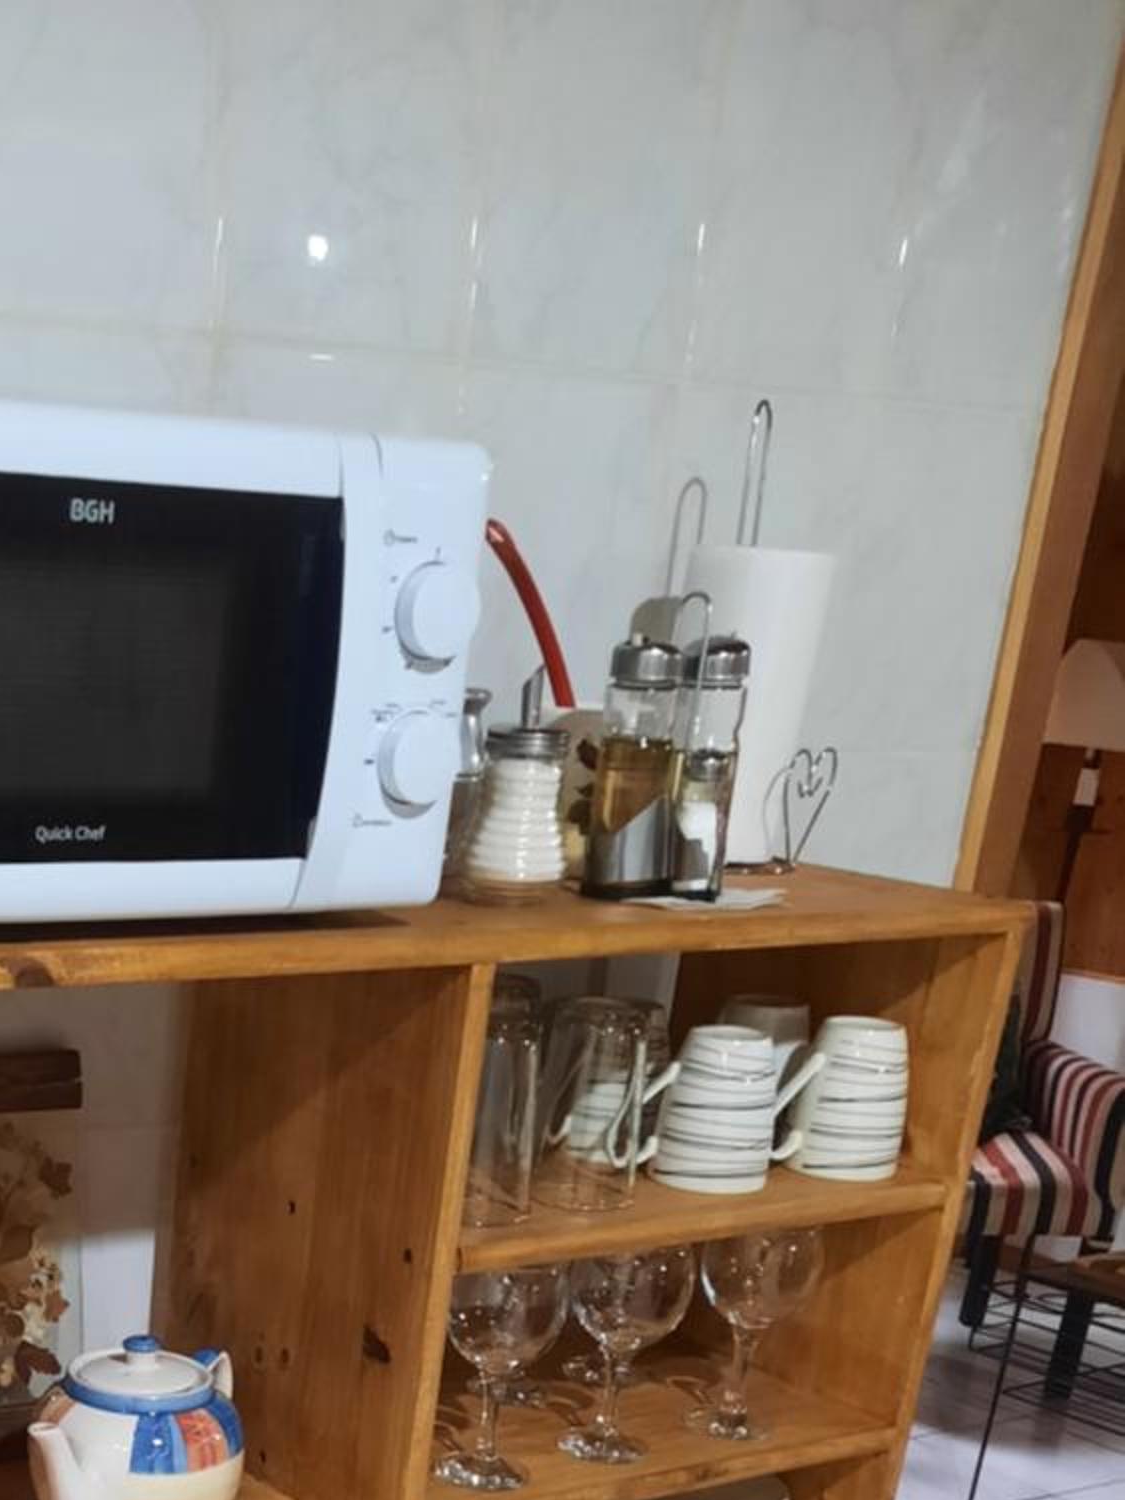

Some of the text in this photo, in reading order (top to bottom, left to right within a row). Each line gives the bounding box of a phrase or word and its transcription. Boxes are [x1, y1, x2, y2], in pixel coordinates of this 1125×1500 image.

[70, 497, 115, 524] BGH
[36, 824, 106, 844] Quick Chef
